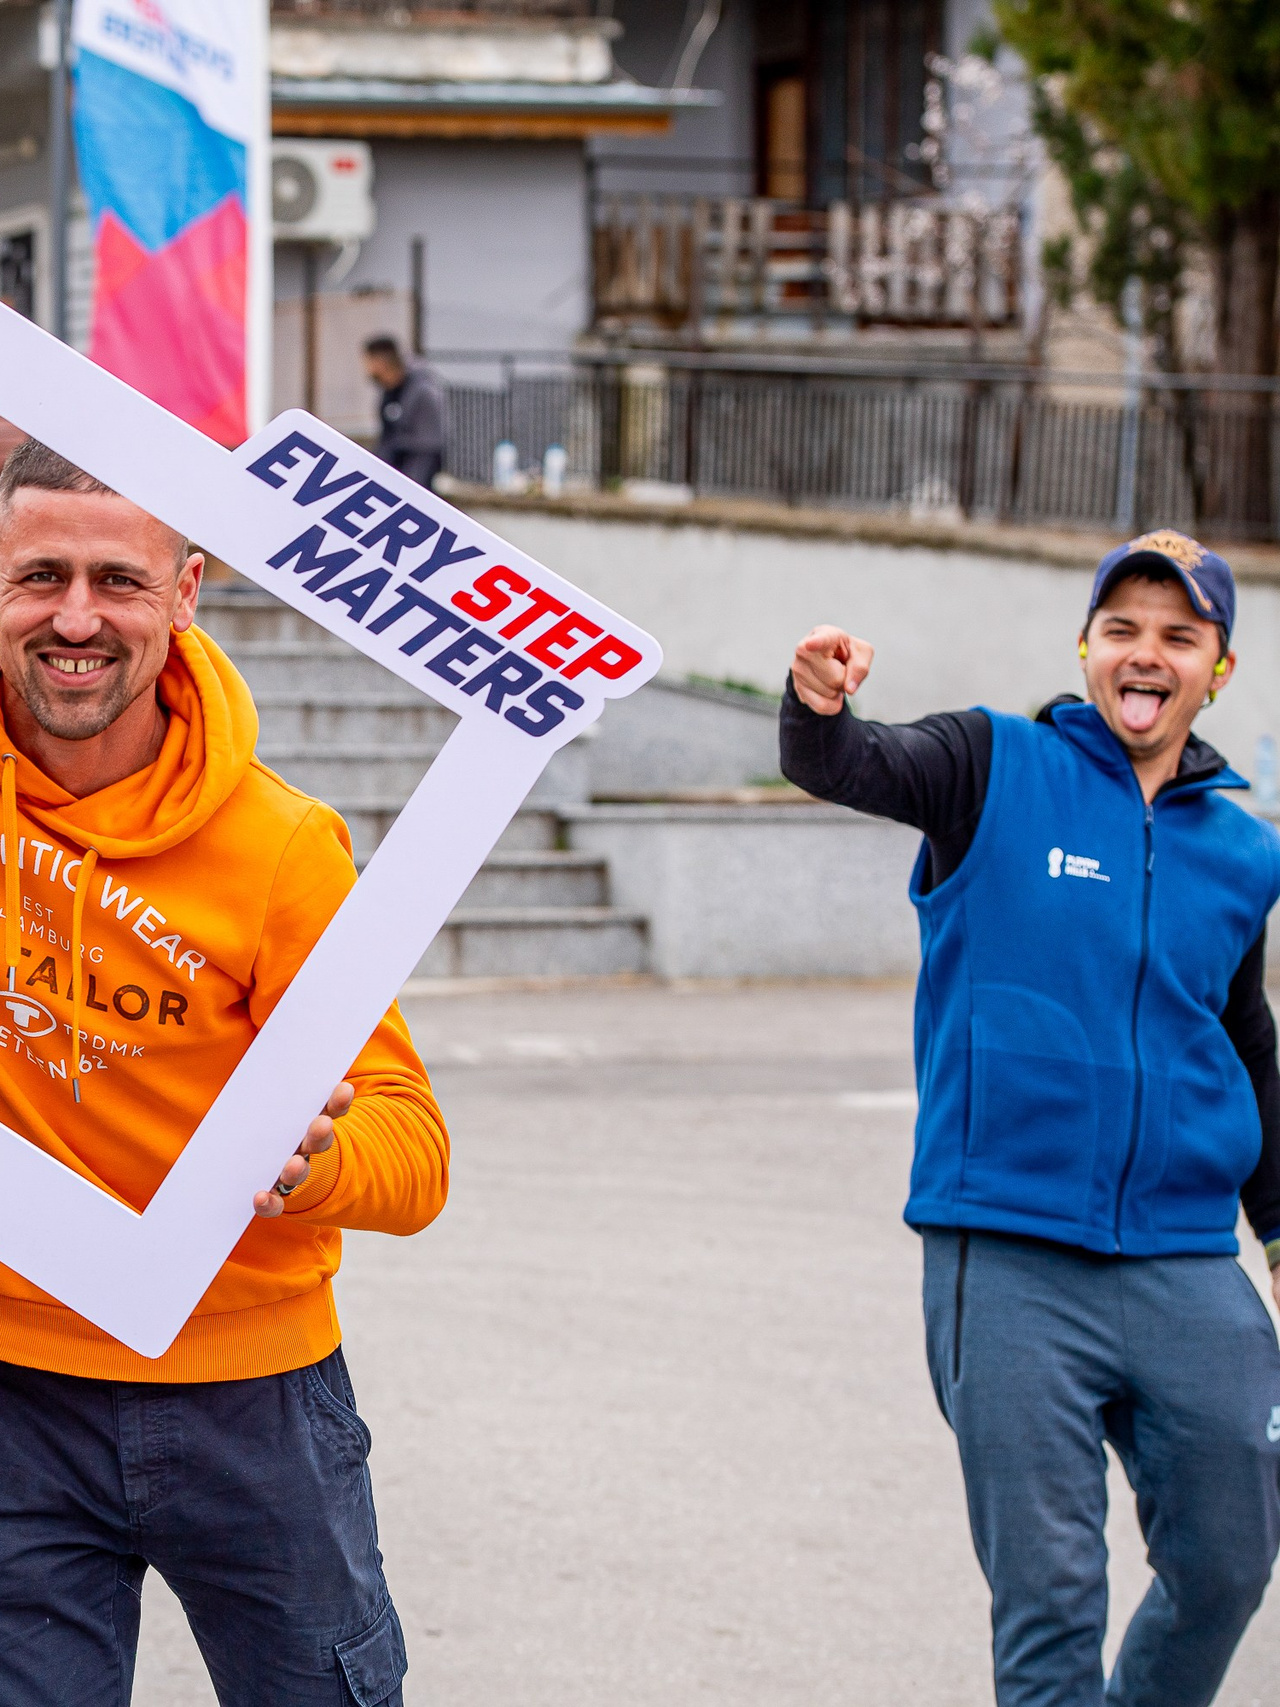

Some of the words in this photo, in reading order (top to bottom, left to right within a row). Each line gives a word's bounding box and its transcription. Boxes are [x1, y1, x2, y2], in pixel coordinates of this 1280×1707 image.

[245, 430, 486, 583] EVERY
[451, 565, 643, 680] STEP
[266, 524, 585, 738] MATTERS
[23, 894, 54, 922] EST
[100, 875, 207, 982] WEAR
